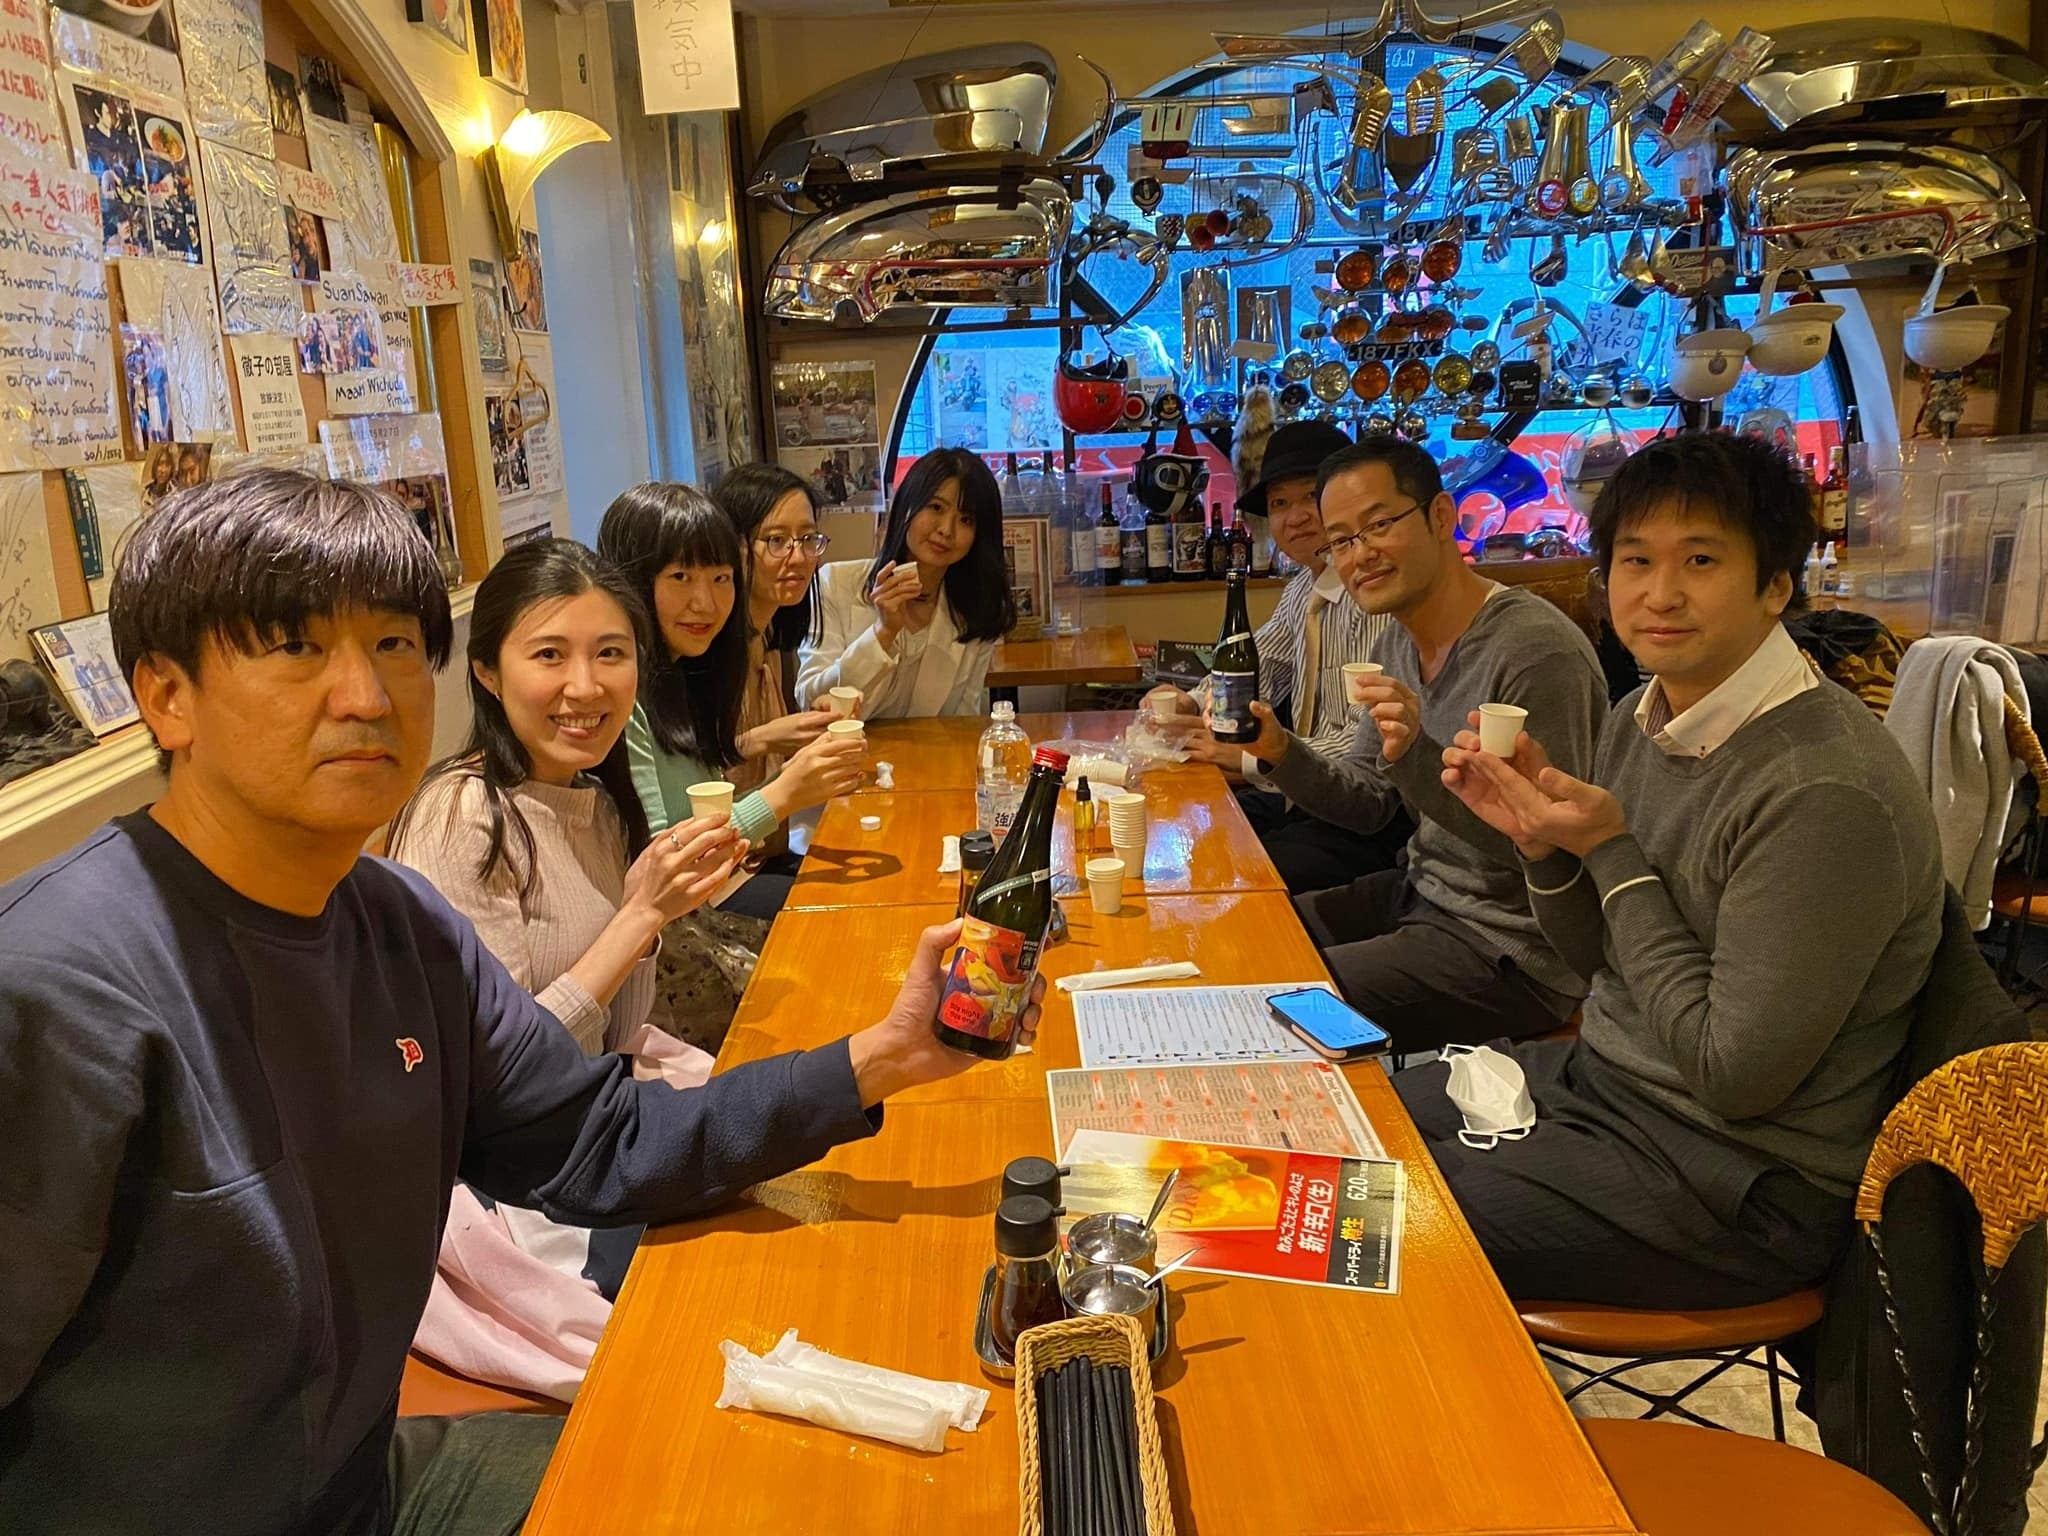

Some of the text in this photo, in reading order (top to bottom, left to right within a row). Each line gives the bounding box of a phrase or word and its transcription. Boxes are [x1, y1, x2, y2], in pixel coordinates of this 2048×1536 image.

[241, 355, 293, 377] 徹子の部屋
[1346, 1177, 1368, 1200] 620
[1276, 1172, 1305, 1254] 飲みごたえとキレのよさ
